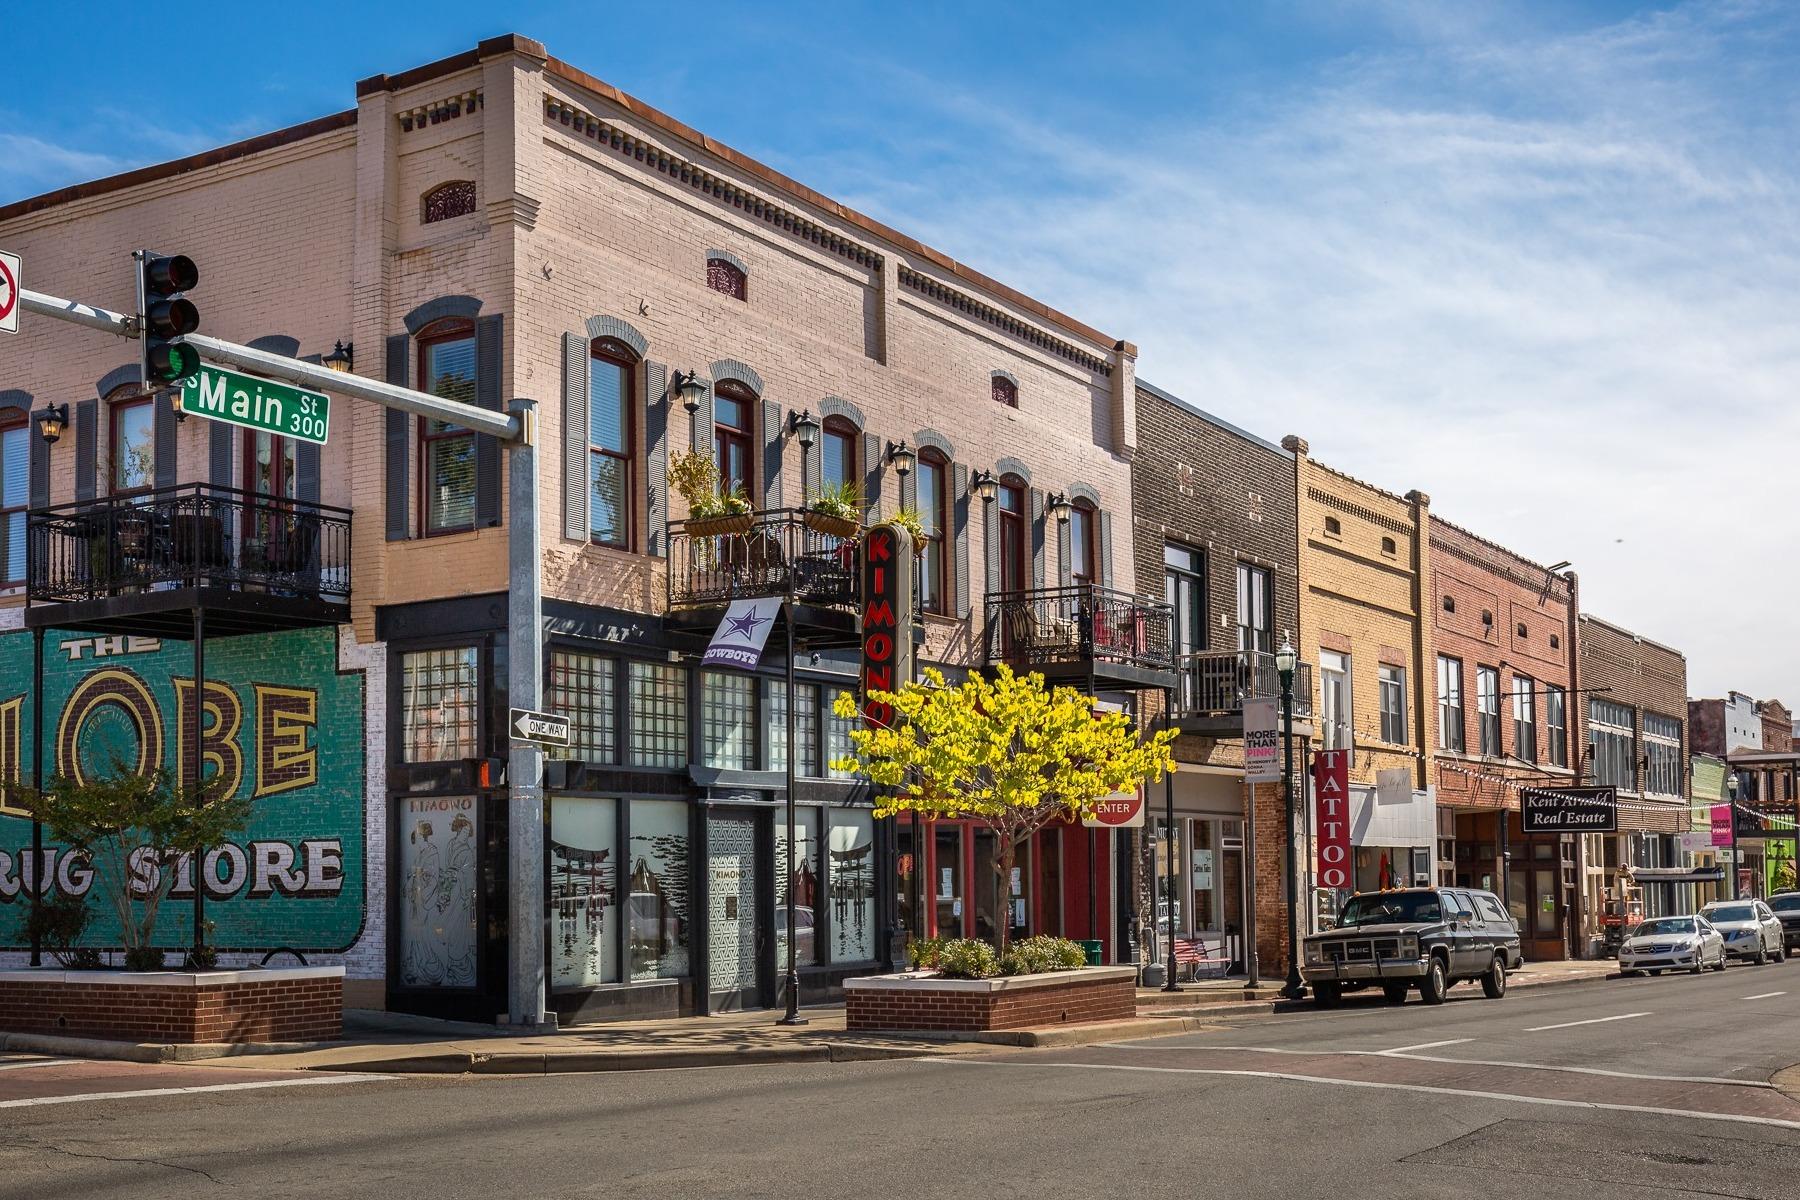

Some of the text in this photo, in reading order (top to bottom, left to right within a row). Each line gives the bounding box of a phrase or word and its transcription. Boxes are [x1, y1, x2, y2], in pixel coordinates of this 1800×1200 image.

[198, 371, 283, 427] Main
[300, 395, 318, 416] St
[290, 413, 325, 438] 300
[864, 532, 896, 728] KIMONO
[59, 635, 162, 660] THE
[704, 648, 758, 665] COWBOYS
[529, 720, 565, 737] ONE WAY
[1246, 730, 1276, 740] MORE
[1246, 739, 1277, 748] THAN
[1097, 803, 1130, 814] ENTER
[1527, 796, 1559, 808] Kent
[1321, 751, 1346, 887] TATTOO
[1532, 811, 1606, 825] Real Estate
[128, 840, 346, 899] STORE
[716, 870, 747, 880] KIMONO
